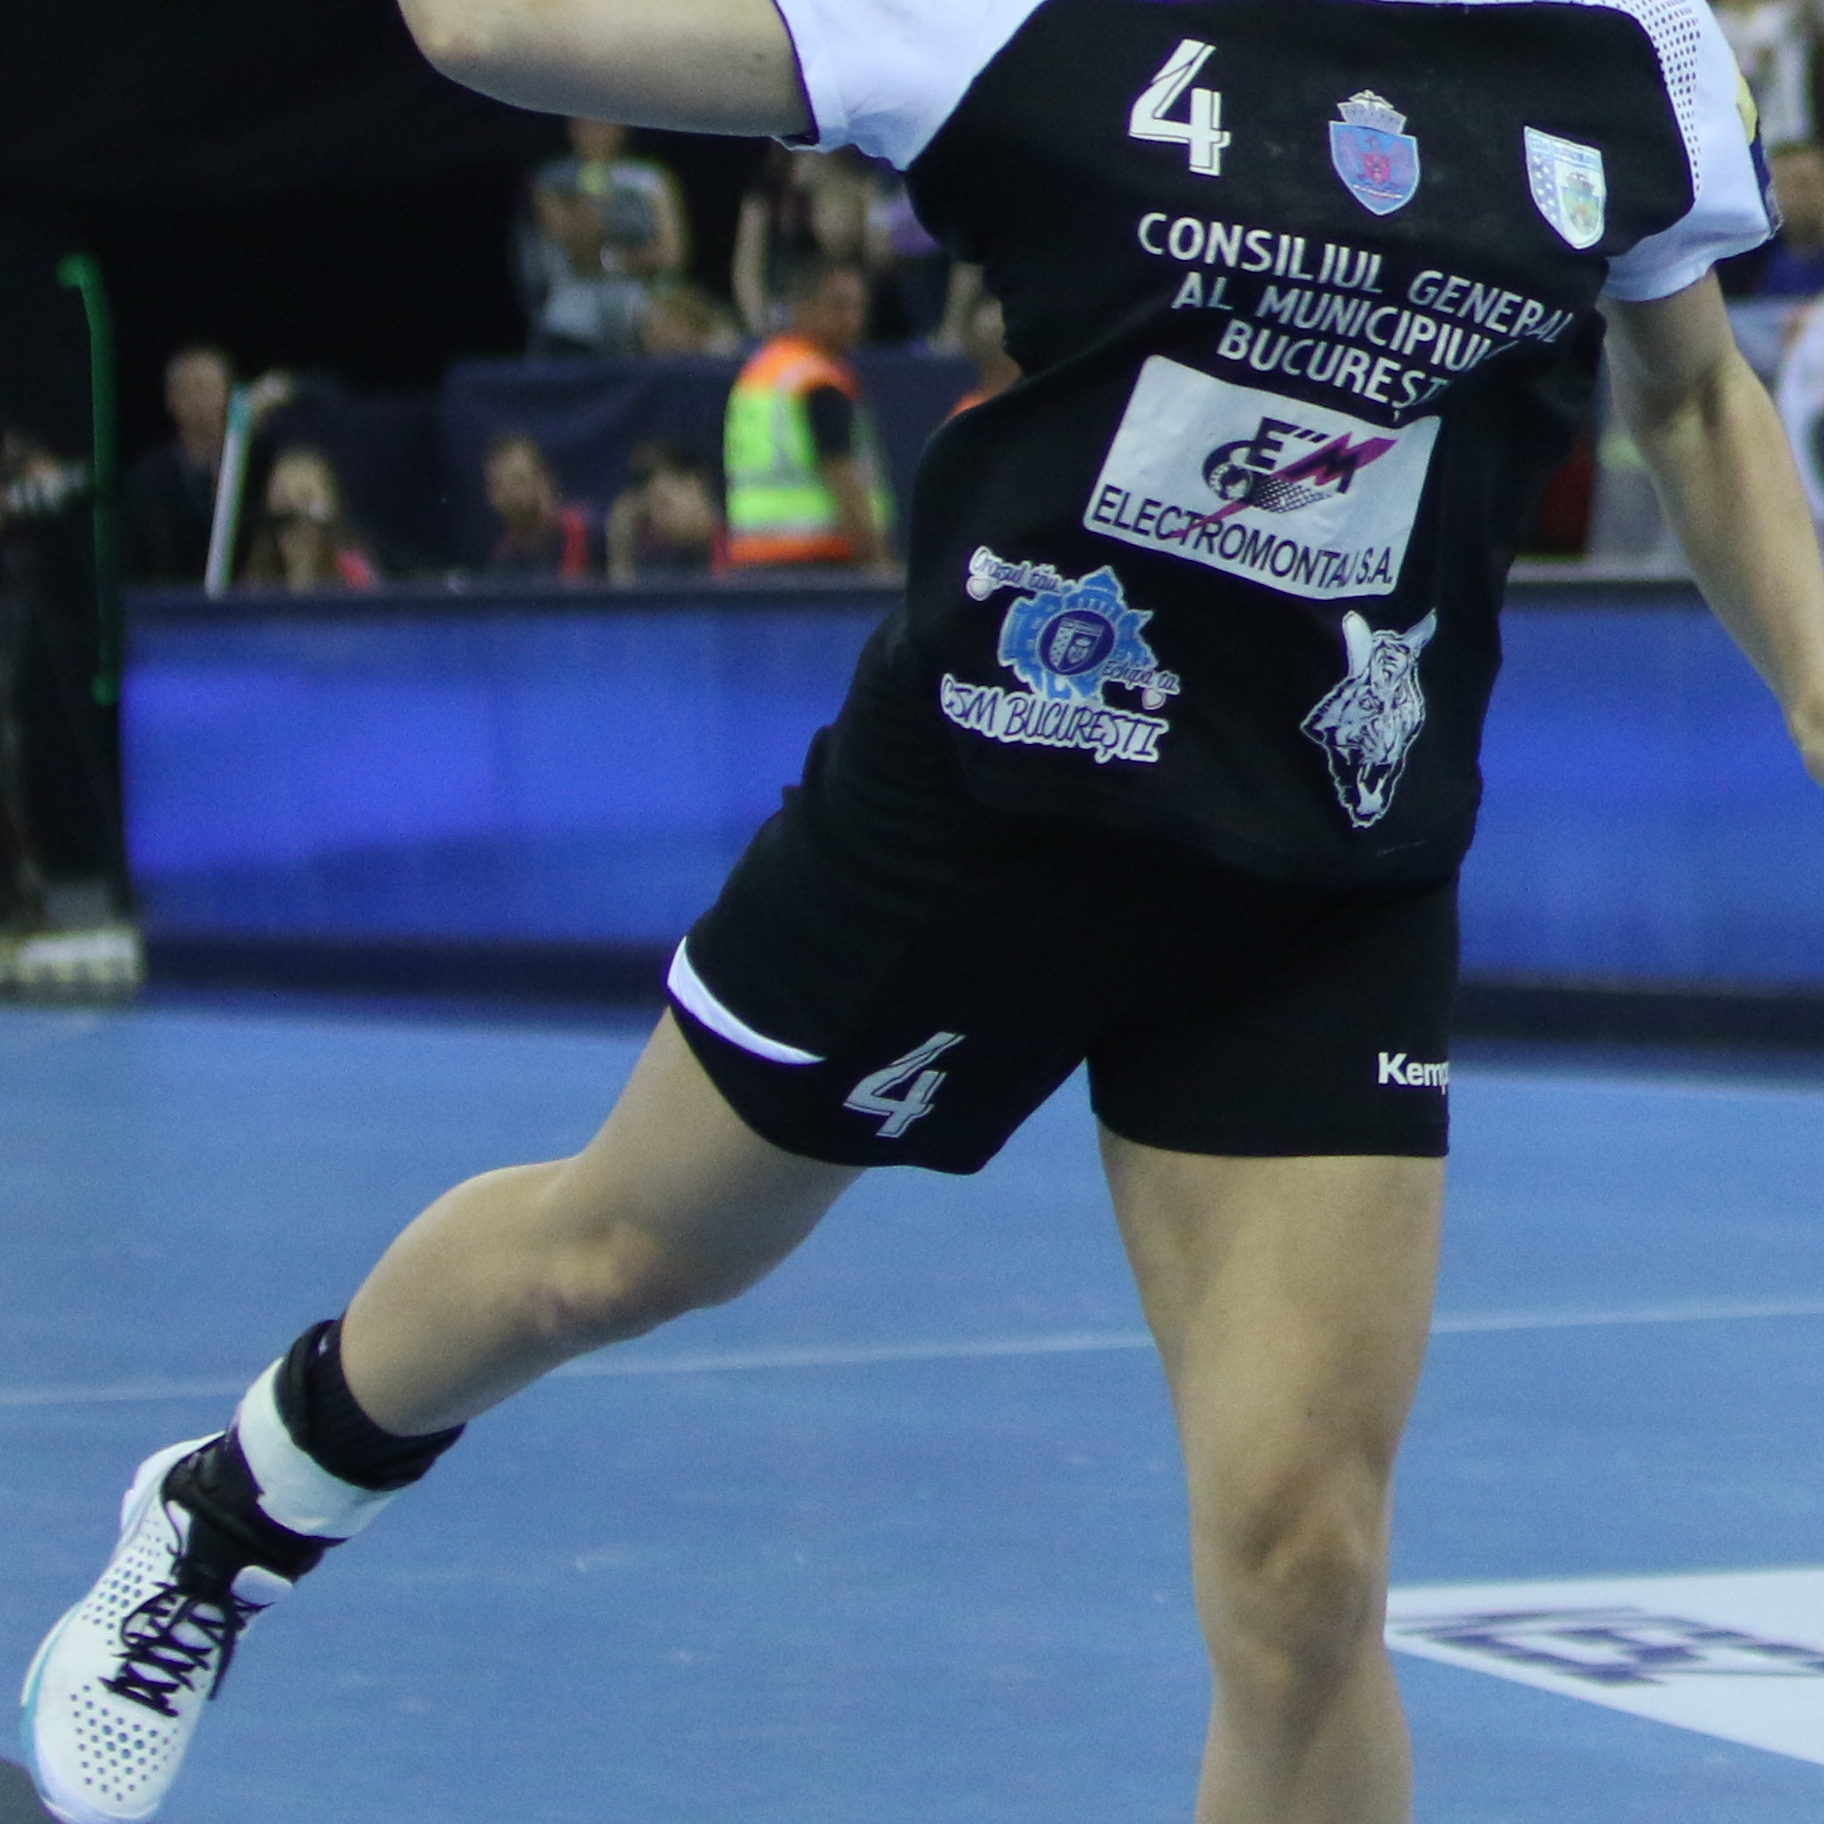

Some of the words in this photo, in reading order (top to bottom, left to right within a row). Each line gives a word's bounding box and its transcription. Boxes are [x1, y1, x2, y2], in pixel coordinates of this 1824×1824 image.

[1128, 38, 1233, 177] 4
[1137, 211, 1384, 294] CONSILIUL
[1170, 271, 1233, 311] AL
[841, 1030, 967, 1138] 4
